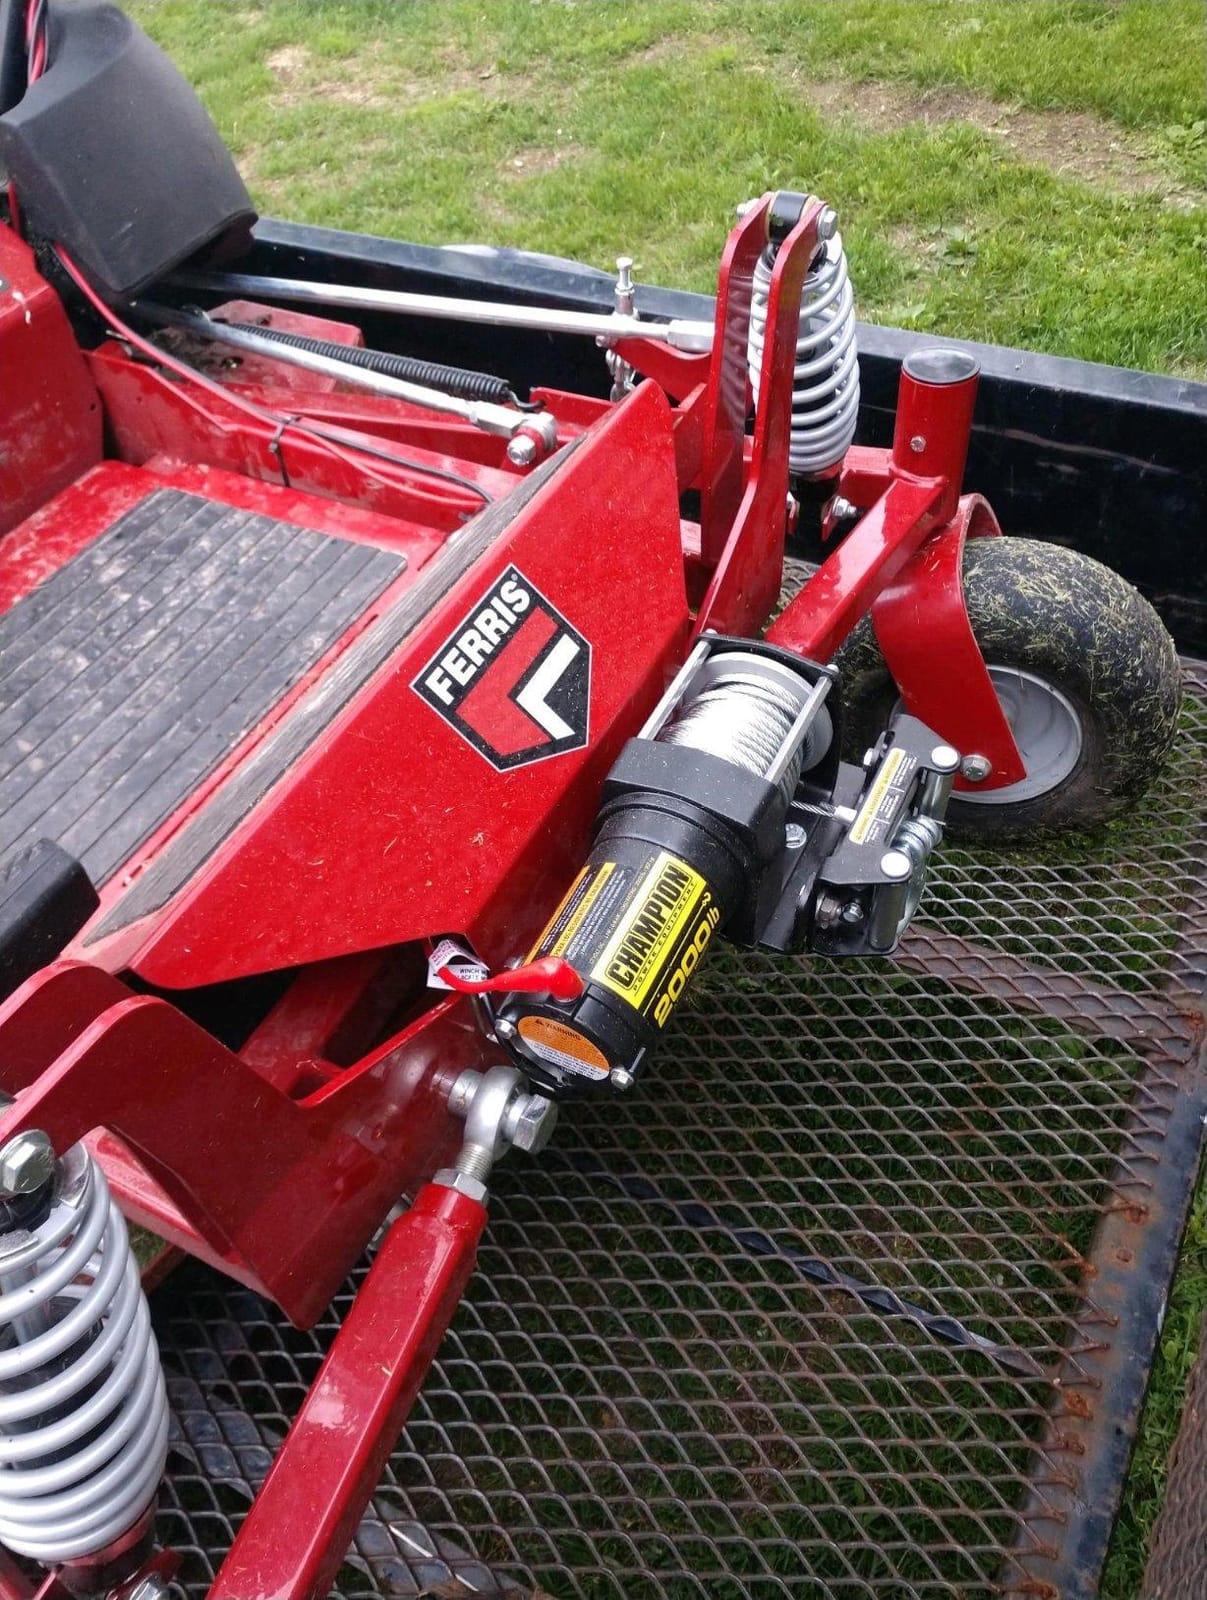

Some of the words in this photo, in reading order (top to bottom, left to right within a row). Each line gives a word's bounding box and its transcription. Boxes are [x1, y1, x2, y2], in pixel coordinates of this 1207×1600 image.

[425, 580, 530, 706] FERRIS
[607, 864, 691, 988] CHAMPION
[632, 950, 657, 992] POWER
[657, 881, 696, 947] EQUIPMENT
